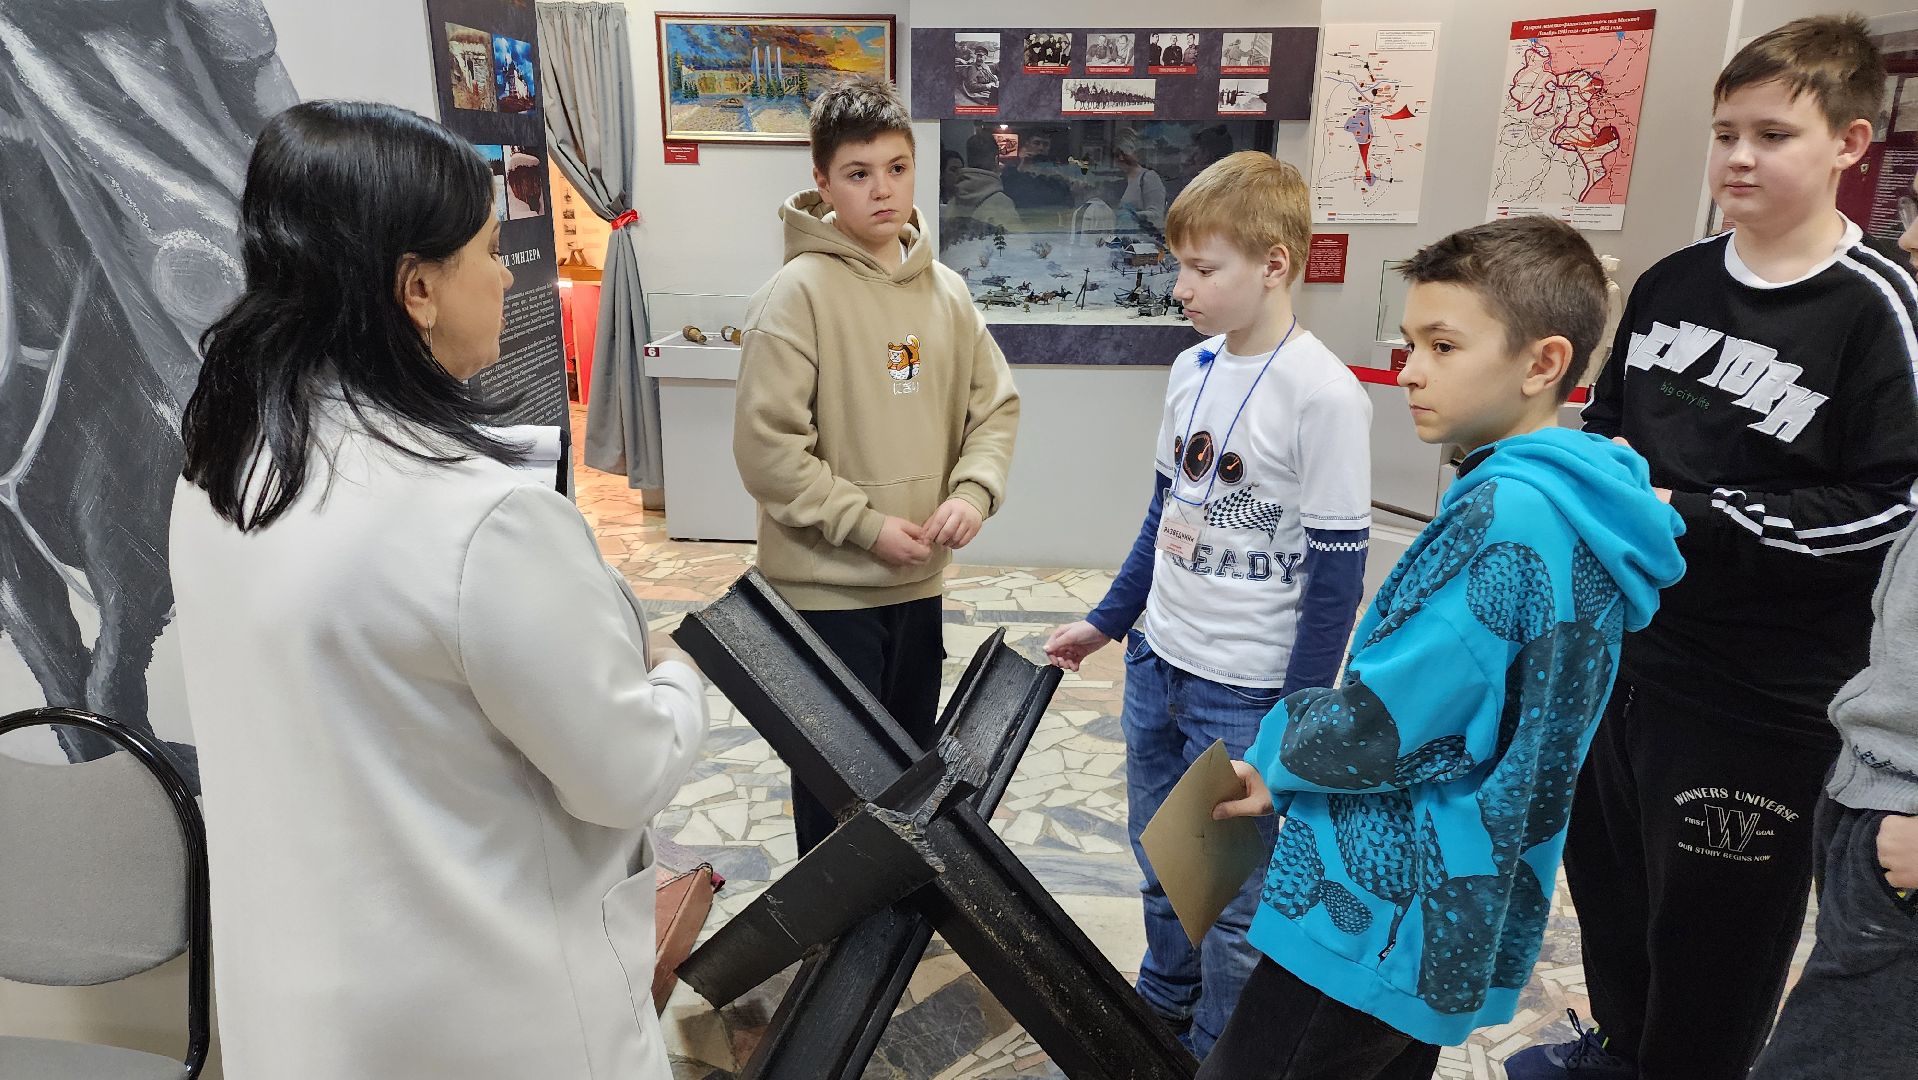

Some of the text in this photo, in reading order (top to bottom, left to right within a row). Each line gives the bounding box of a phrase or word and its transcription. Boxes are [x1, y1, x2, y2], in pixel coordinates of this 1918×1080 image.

[512, 247, 541, 266] ЗИНДЕРА
[648, 347, 656, 357] 6
[1660, 381, 1710, 410] big city life
[1696, 335, 1830, 443] YORK
[1673, 787, 1799, 823] WINNERS UNIVERSE
[1684, 816, 1706, 827] FIRST
[1703, 803, 1761, 852] W
[1677, 841, 1693, 852] OUR
[1694, 846, 1721, 857] STORY
[1722, 852, 1753, 862] BEGINS
